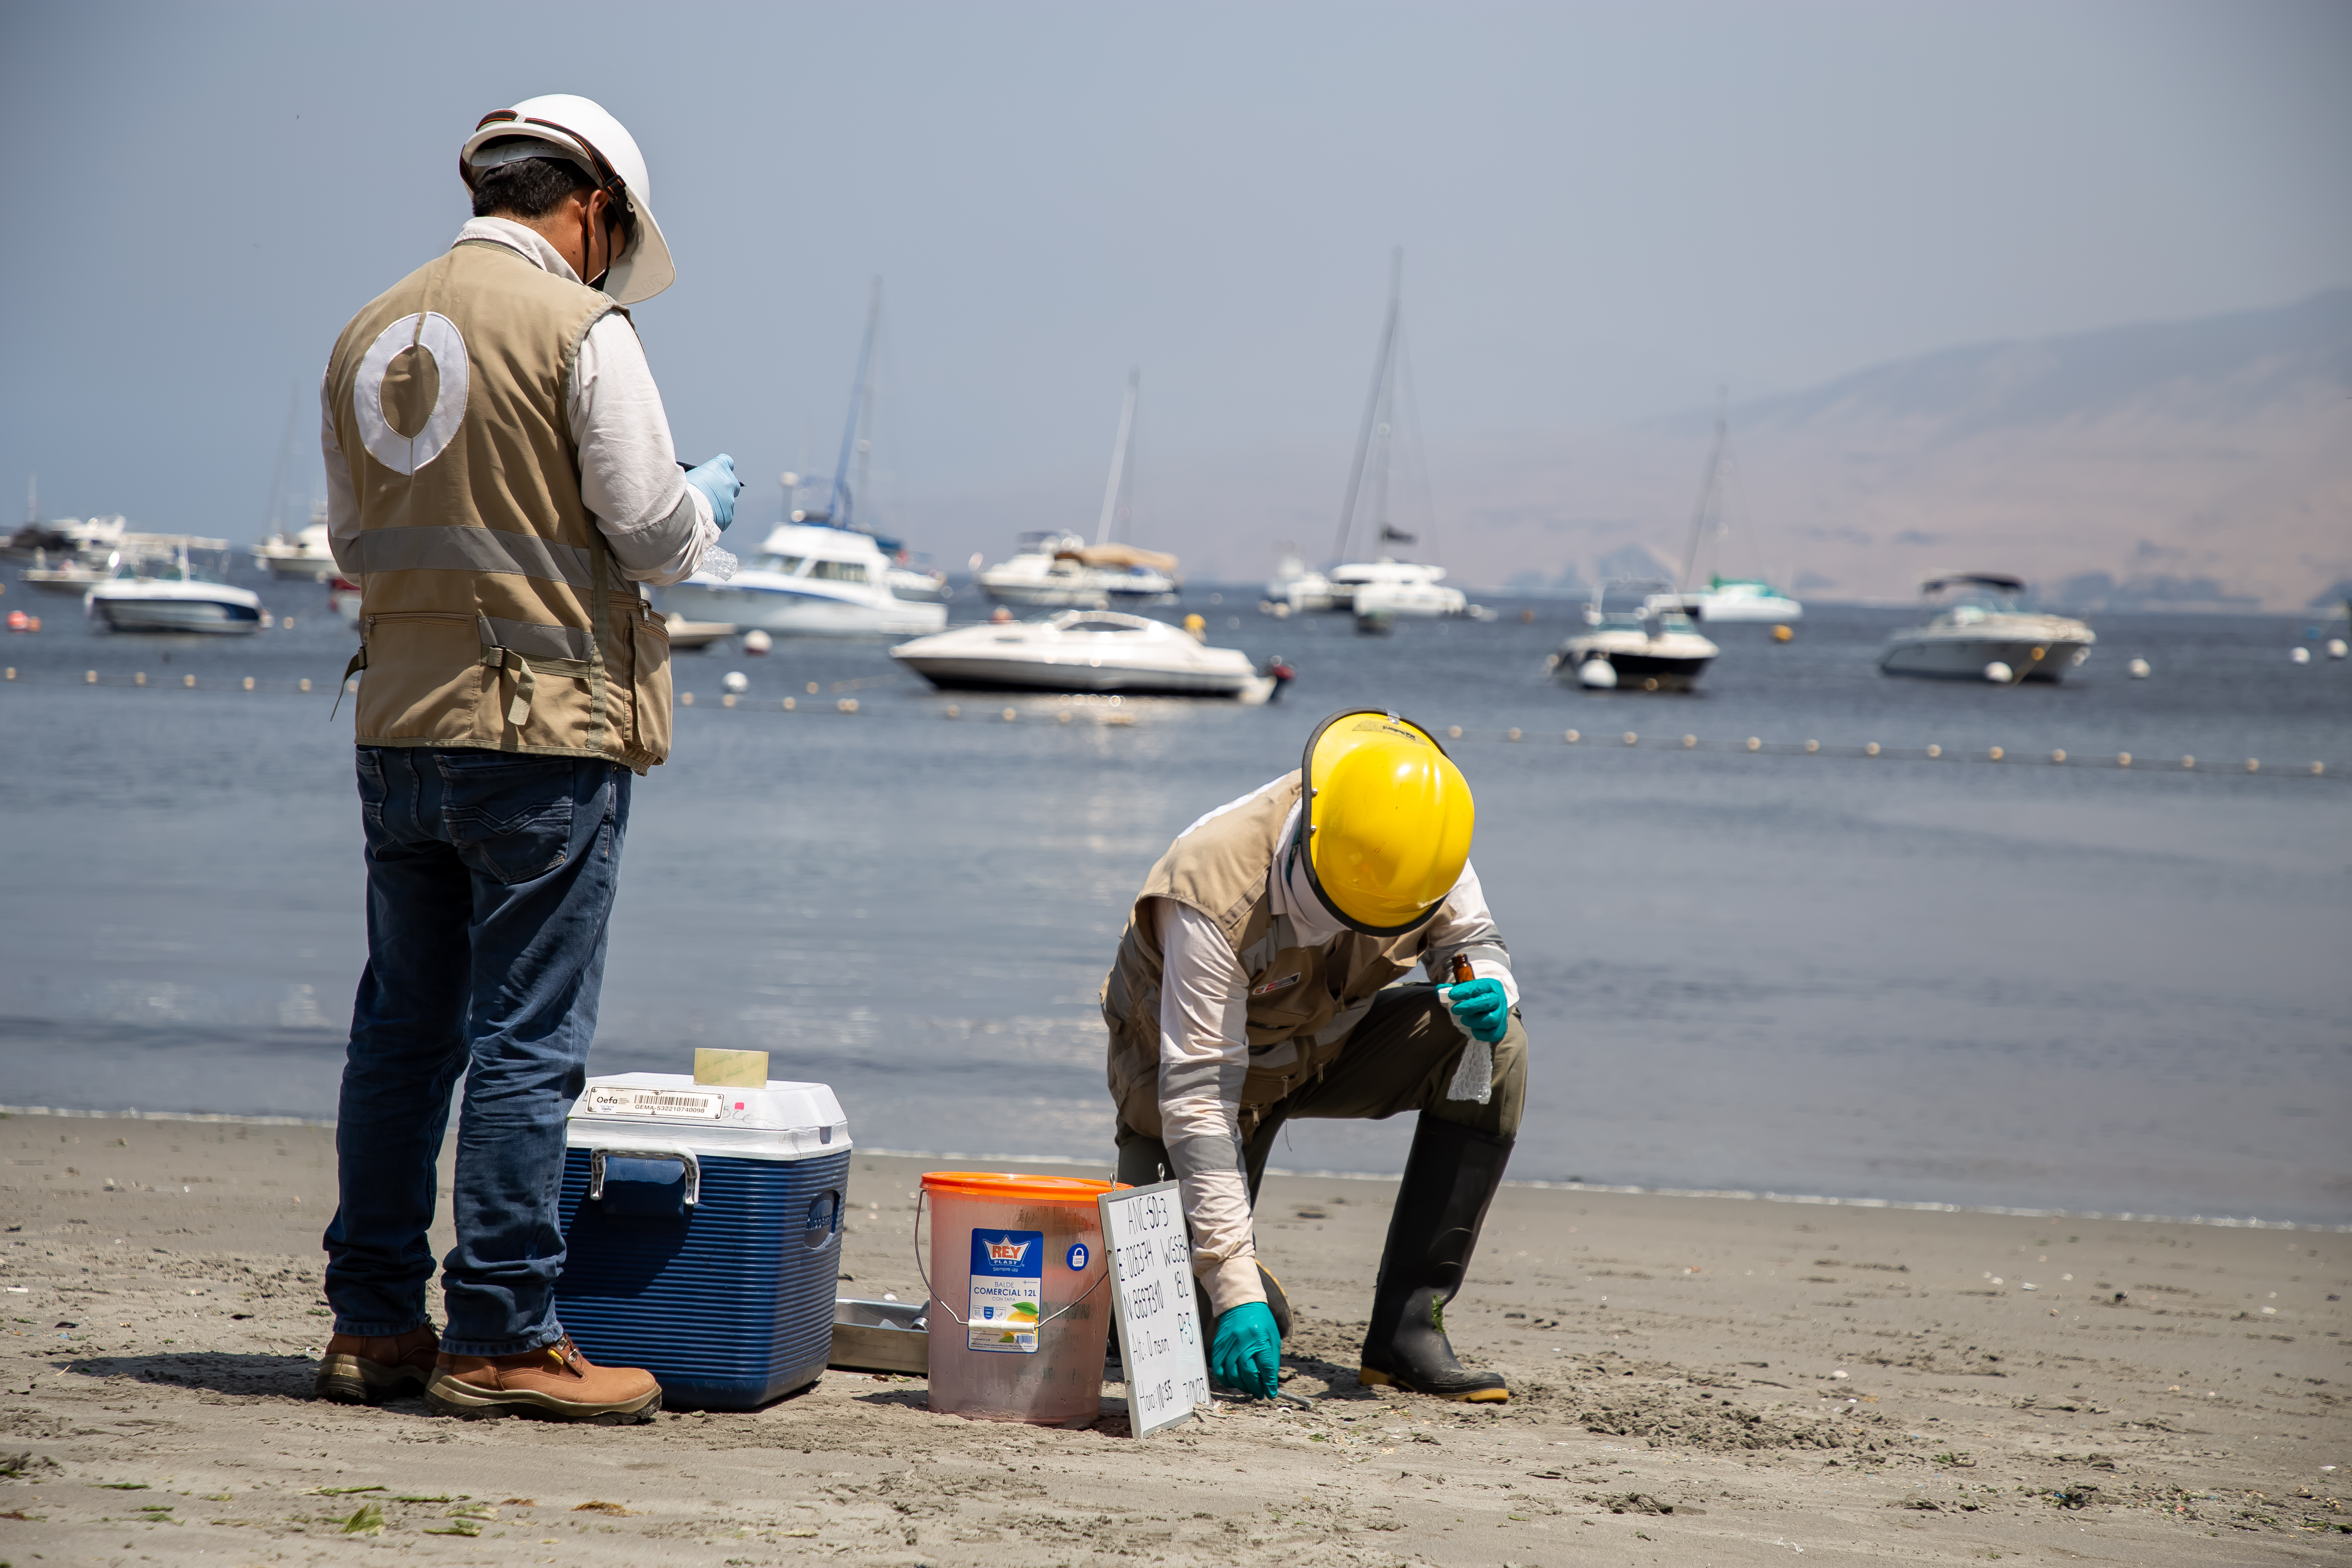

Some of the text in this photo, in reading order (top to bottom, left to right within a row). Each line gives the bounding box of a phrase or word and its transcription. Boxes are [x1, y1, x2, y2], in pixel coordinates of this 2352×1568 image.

[635, 1104, 704, 1113] GEMA-532210740098
[1127, 1196, 1169, 1234] ANC-SD-3
[992, 1246, 1022, 1259] REY
[1160, 1234, 1190, 1268] WGS84
[974, 1287, 1021, 1296] COMERCIAL
[1175, 1270, 1189, 1299] 18L
